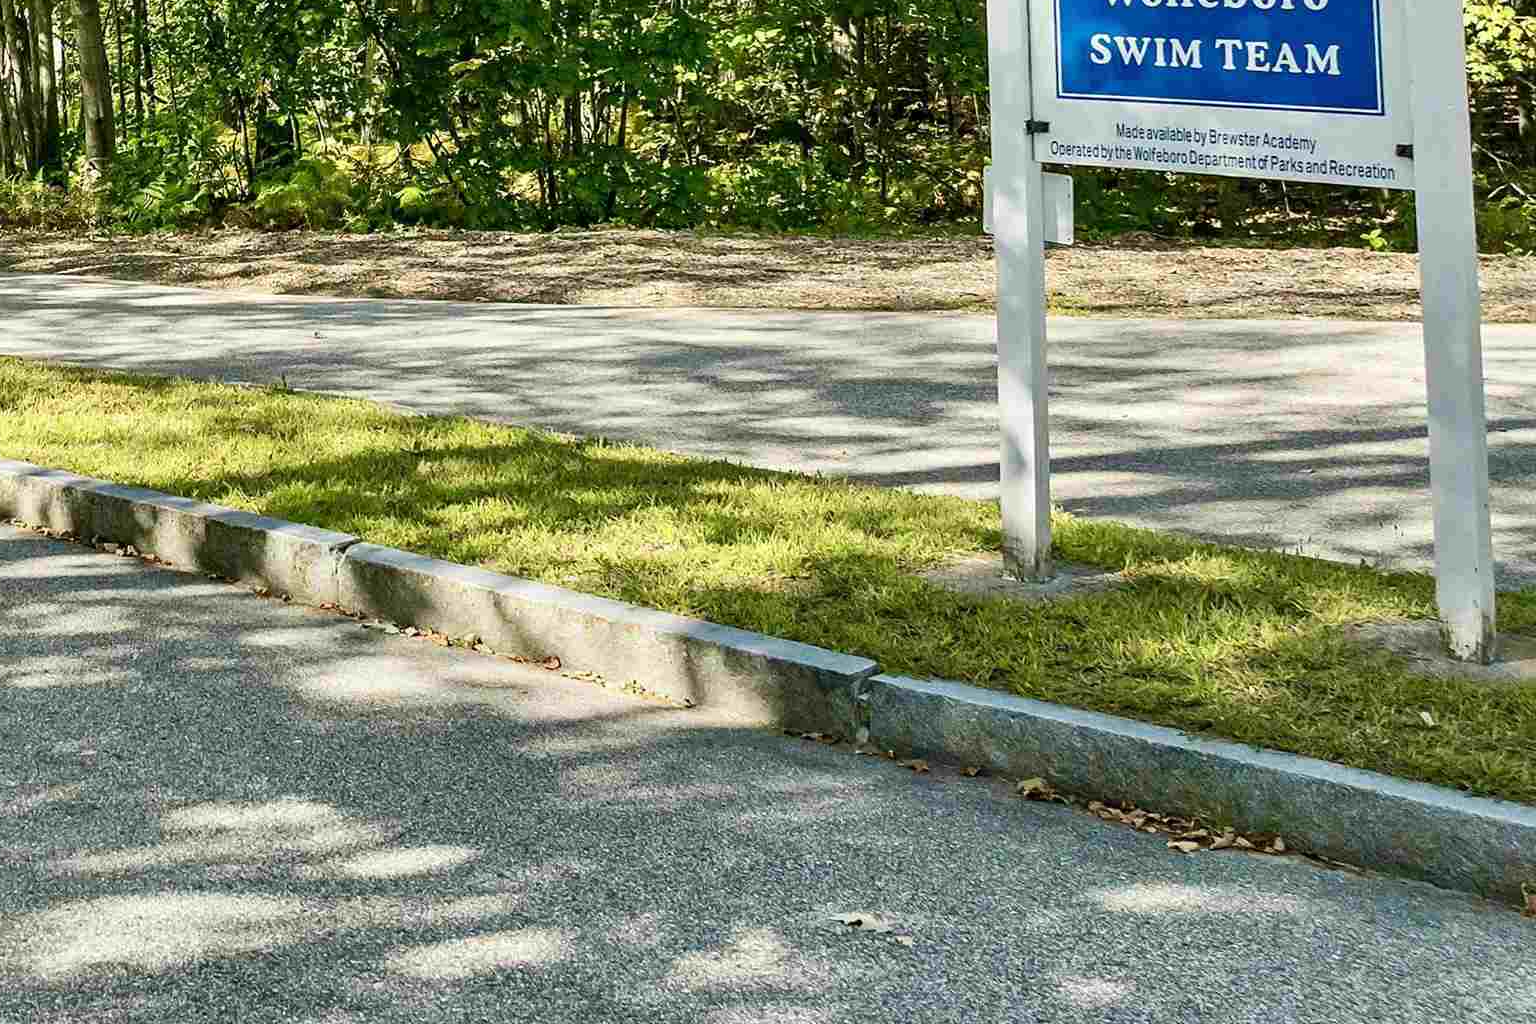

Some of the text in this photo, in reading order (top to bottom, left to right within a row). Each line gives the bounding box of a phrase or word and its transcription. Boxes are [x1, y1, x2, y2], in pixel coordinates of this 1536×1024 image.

[1089, 33, 1341, 75] SWIM TEAM
[1116, 123, 1317, 154] Made available by Brewster Academy
[1050, 140, 1396, 180] Operated by the Wolfeboro Department of Parks and Recreation
